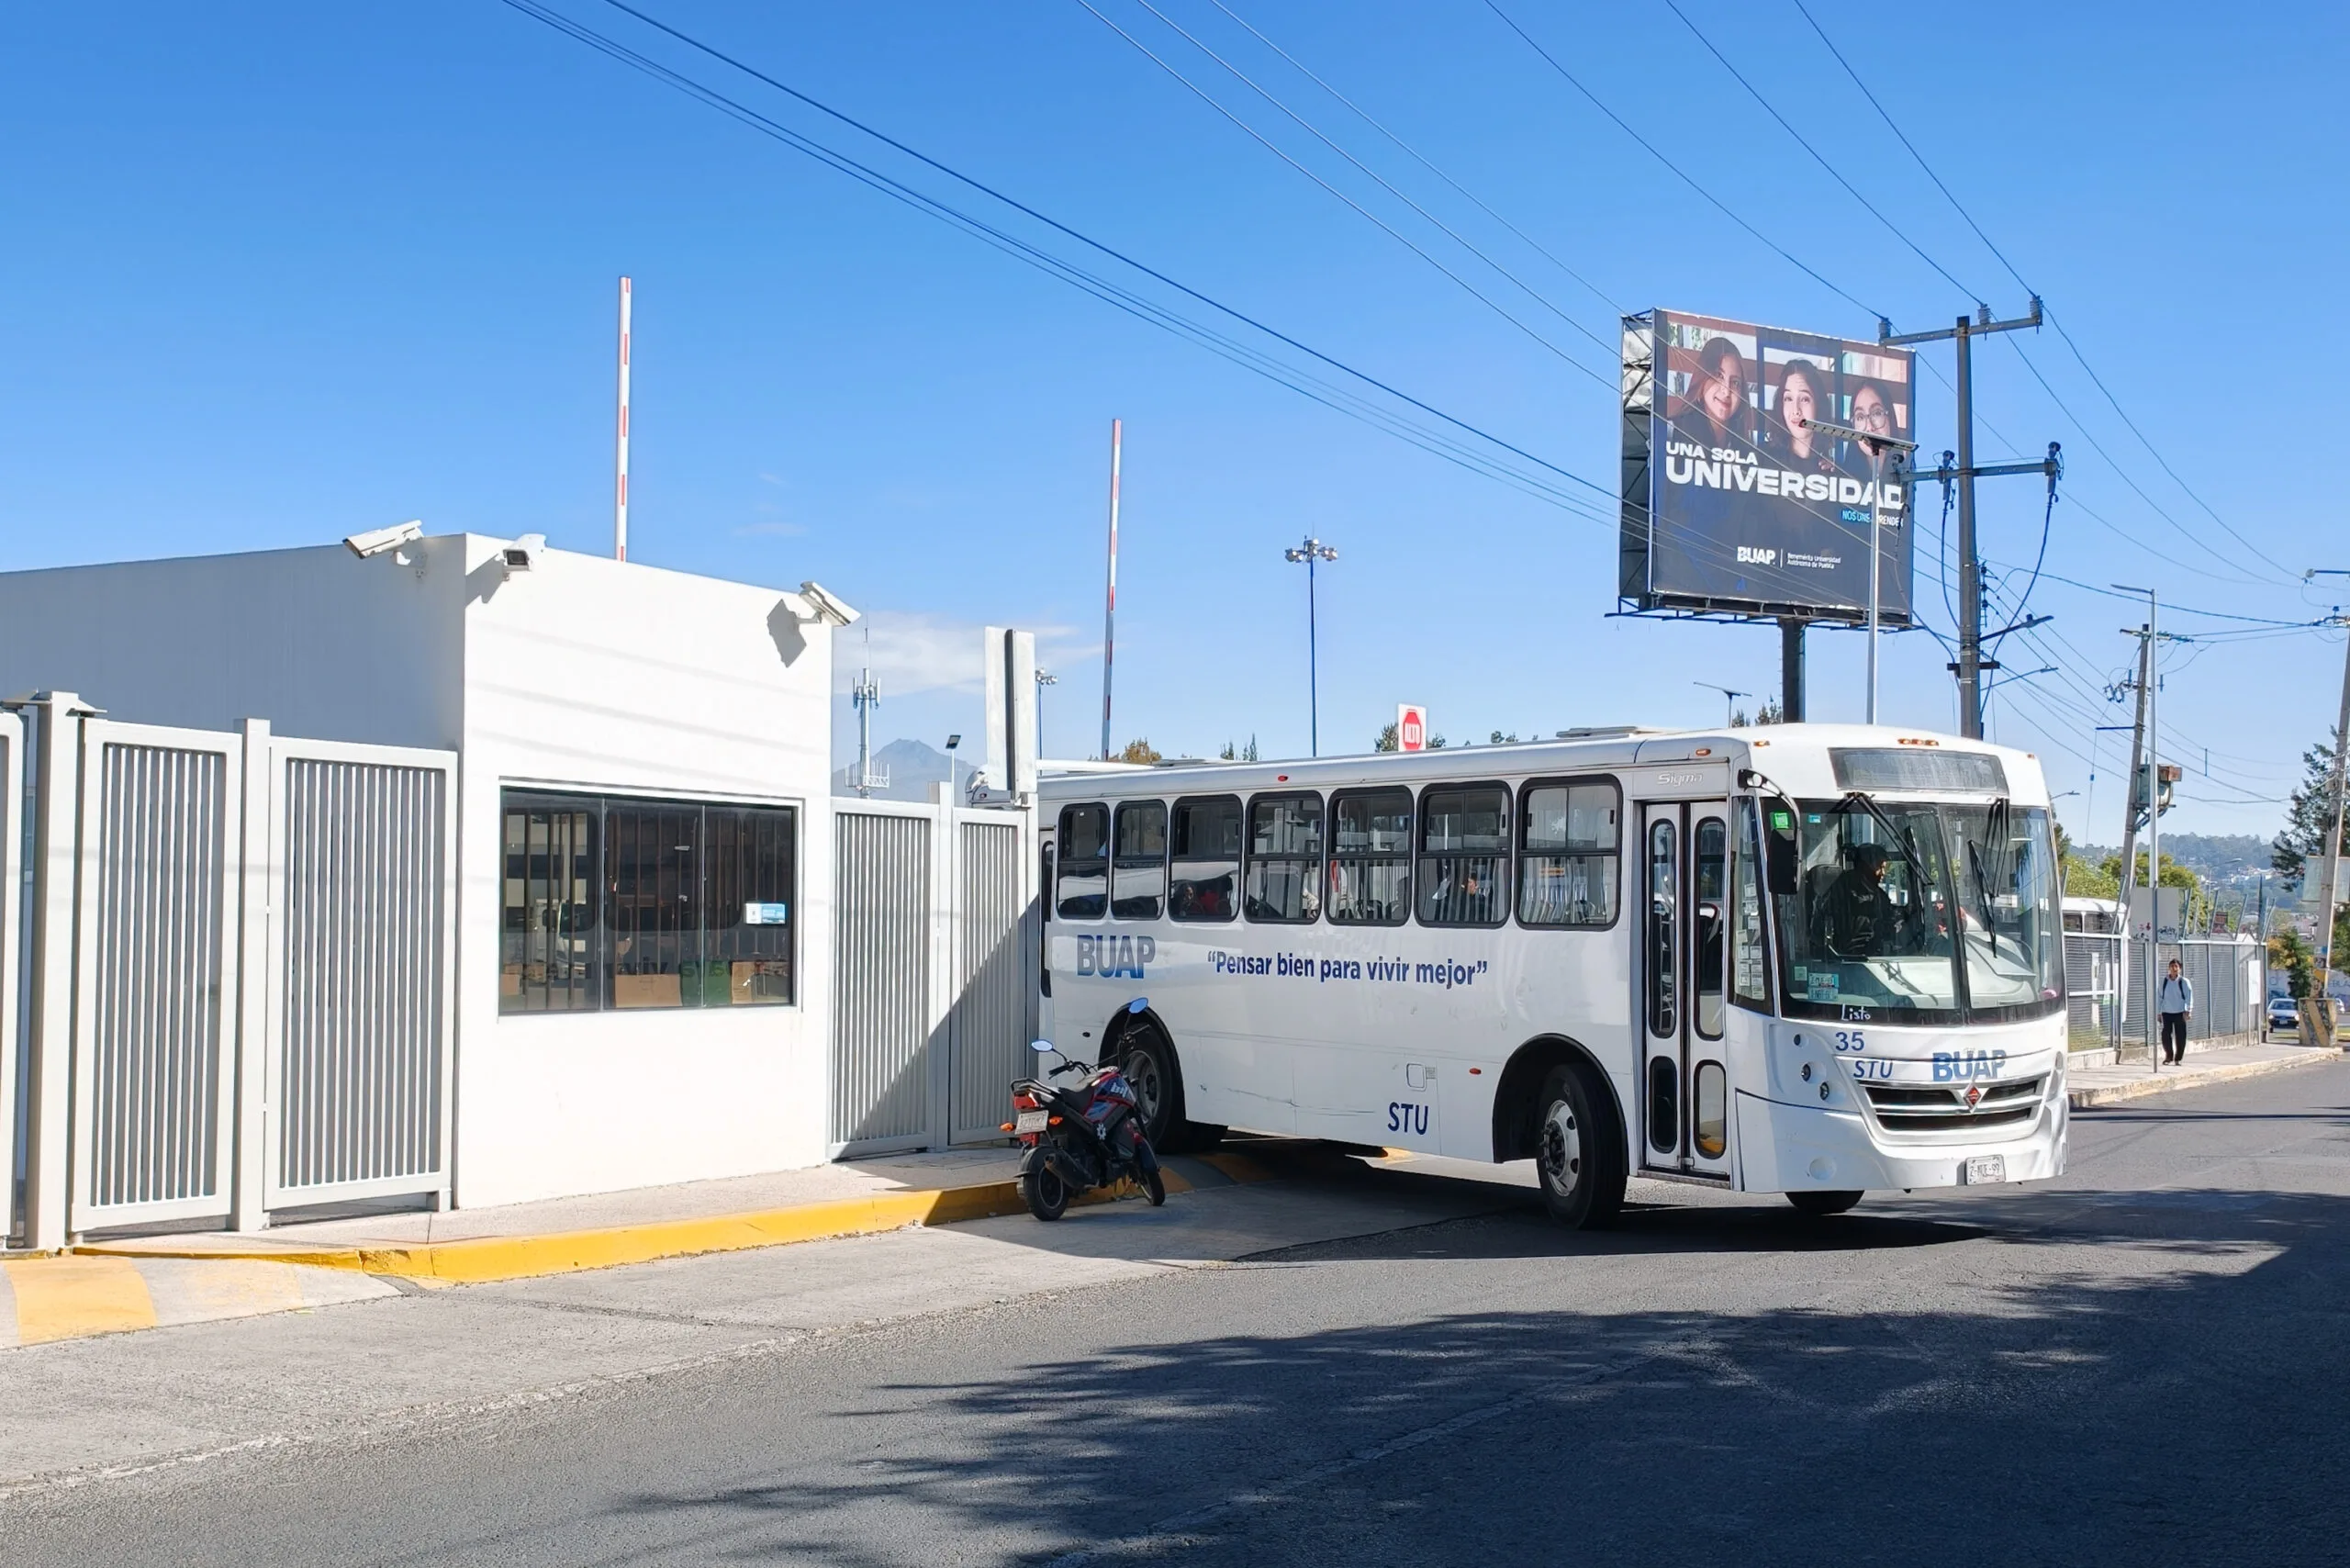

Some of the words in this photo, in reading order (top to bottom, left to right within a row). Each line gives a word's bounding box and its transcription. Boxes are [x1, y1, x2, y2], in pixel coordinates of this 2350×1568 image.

[1666, 441, 1704, 460] UNA
[1711, 447, 1758, 465] SOLA
[1665, 457, 1903, 510] UNIVERSIDAD
[1737, 545, 1776, 565] BUAP
[1404, 722, 1421, 744] ALTO
[1656, 772, 1704, 788] Sigma
[1077, 934, 1156, 980] BUAP
[1207, 951, 1272, 976] “Pensar
[1277, 955, 1315, 977] bien
[1320, 963, 1361, 982] para
[1366, 956, 1410, 982] vivir
[1416, 961, 1488, 989] mejor”
[1841, 1003, 1872, 1022] Listo
[1835, 1032, 1864, 1051] 35
[1853, 1060, 1893, 1079] STU
[1932, 1049, 2007, 1081] BUAP
[1387, 1102, 1428, 1135] STU
